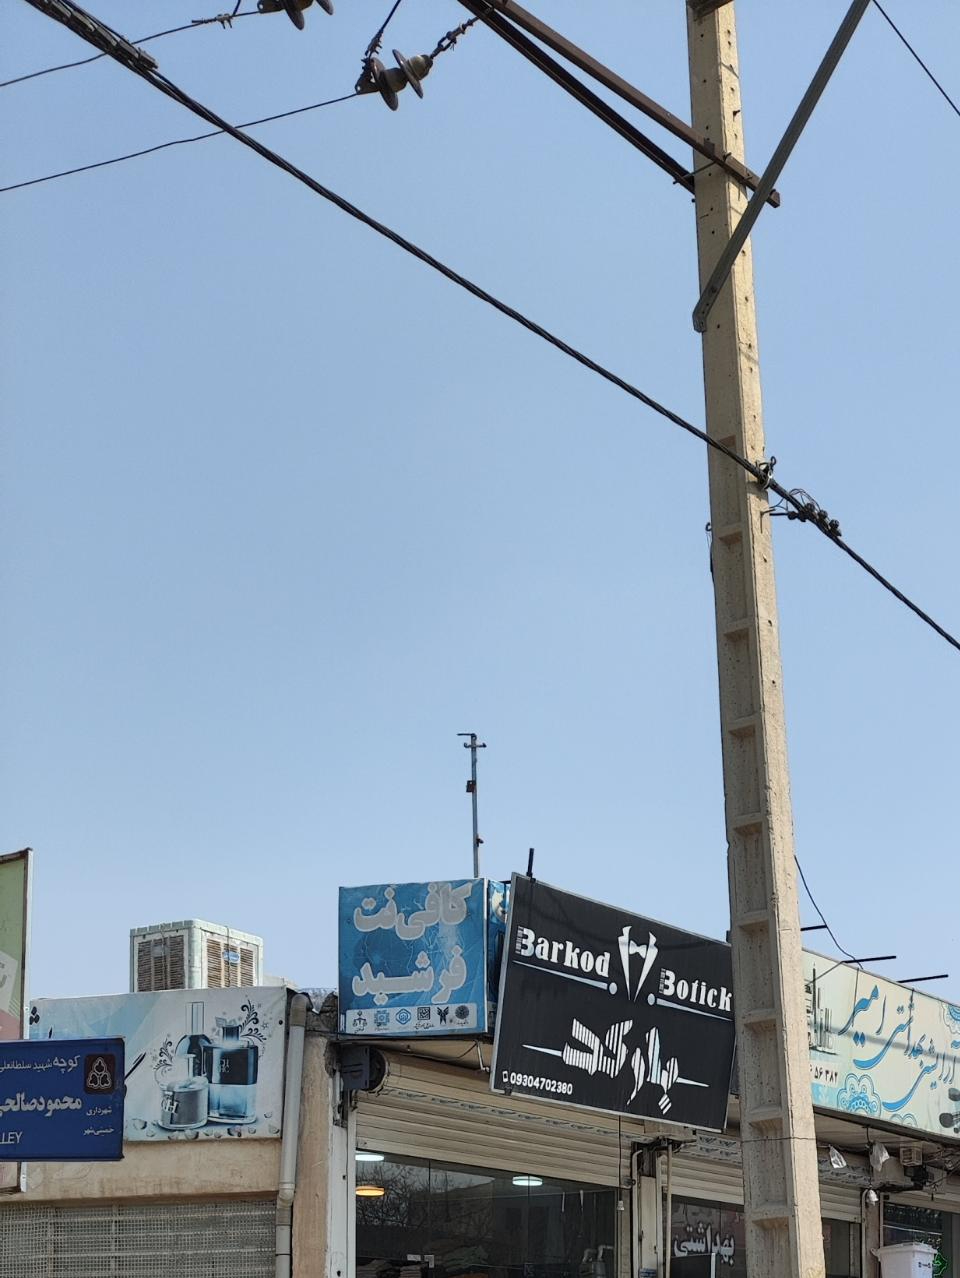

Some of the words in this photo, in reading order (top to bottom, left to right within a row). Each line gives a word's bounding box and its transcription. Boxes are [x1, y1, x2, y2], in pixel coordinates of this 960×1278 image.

[515, 926, 610, 978] Barkod
[352, 945, 467, 1005] فرشید
[658, 968, 733, 1012] Botick
[33, 1059, 53, 1072] شهید
[53, 1055, 80, 1073] کوچه
[562, 1018, 679, 1115] بارکد
[510, 1072, 574, 1096] 09304702380
[37, 1094, 82, 1117] محمود
[86, 1105, 113, 1117] شهرداری
